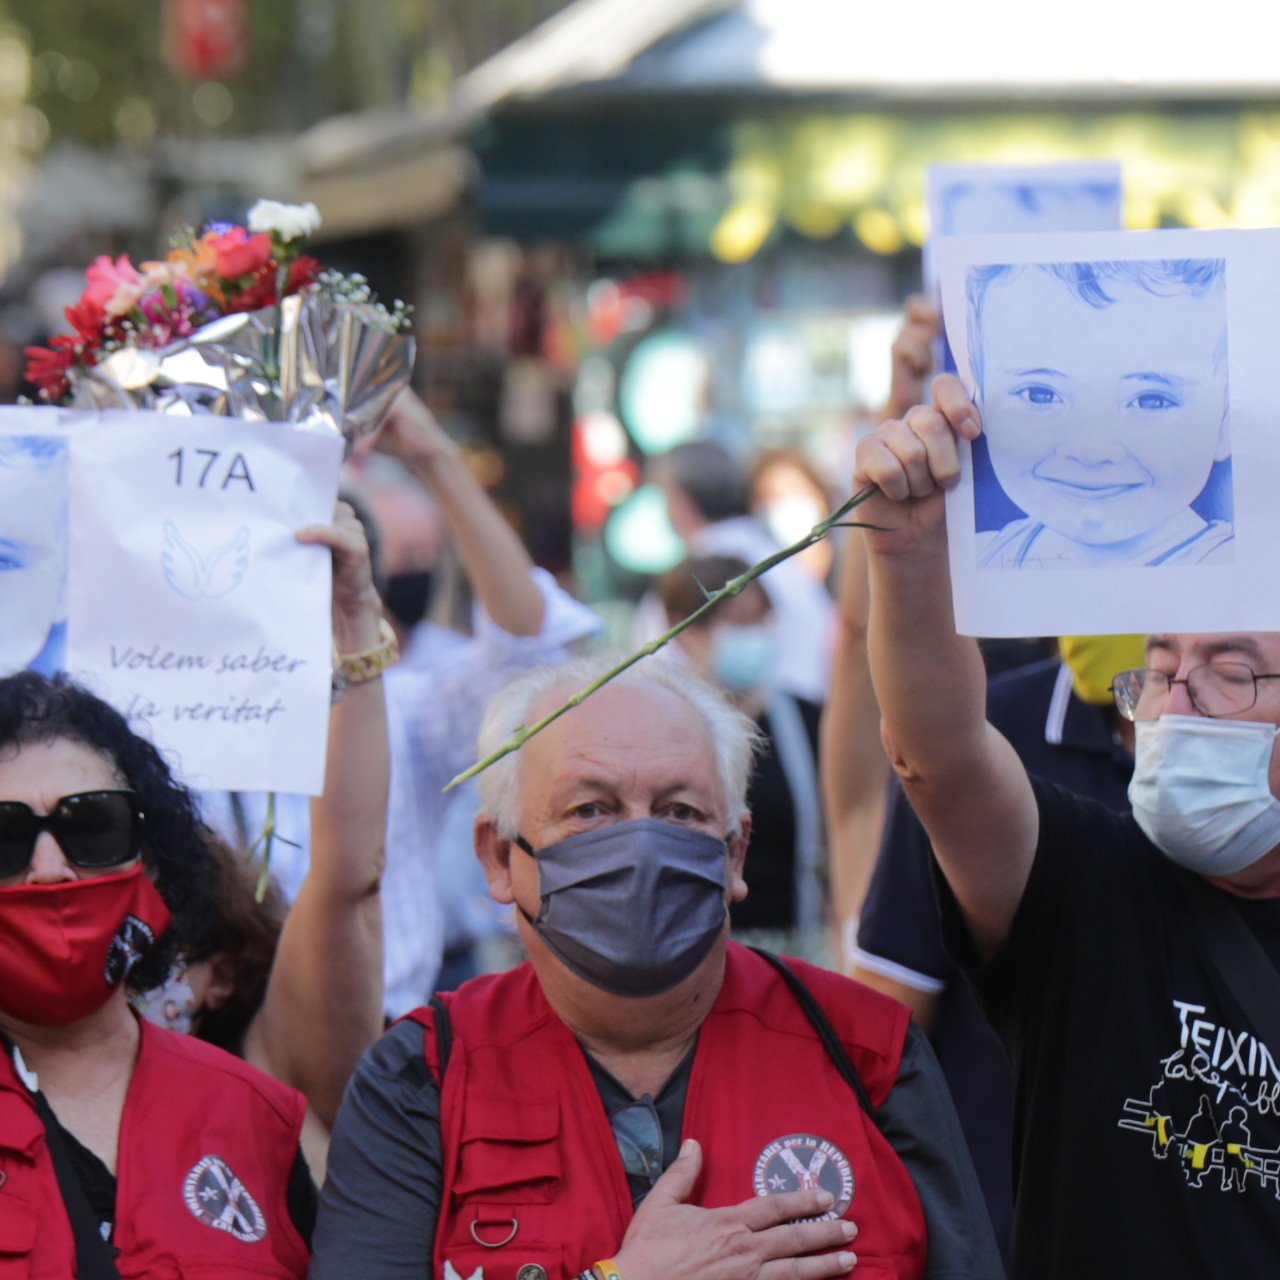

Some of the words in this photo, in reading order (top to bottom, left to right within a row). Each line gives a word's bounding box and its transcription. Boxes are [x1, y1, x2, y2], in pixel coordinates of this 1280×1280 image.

[167, 446, 256, 492] 17A
[109, 645, 212, 671] Volem
[214, 645, 307, 674] saber
[124, 693, 165, 721] la
[173, 696, 287, 724] veritat
[754, 1142, 783, 1197] OLUNTARIS
